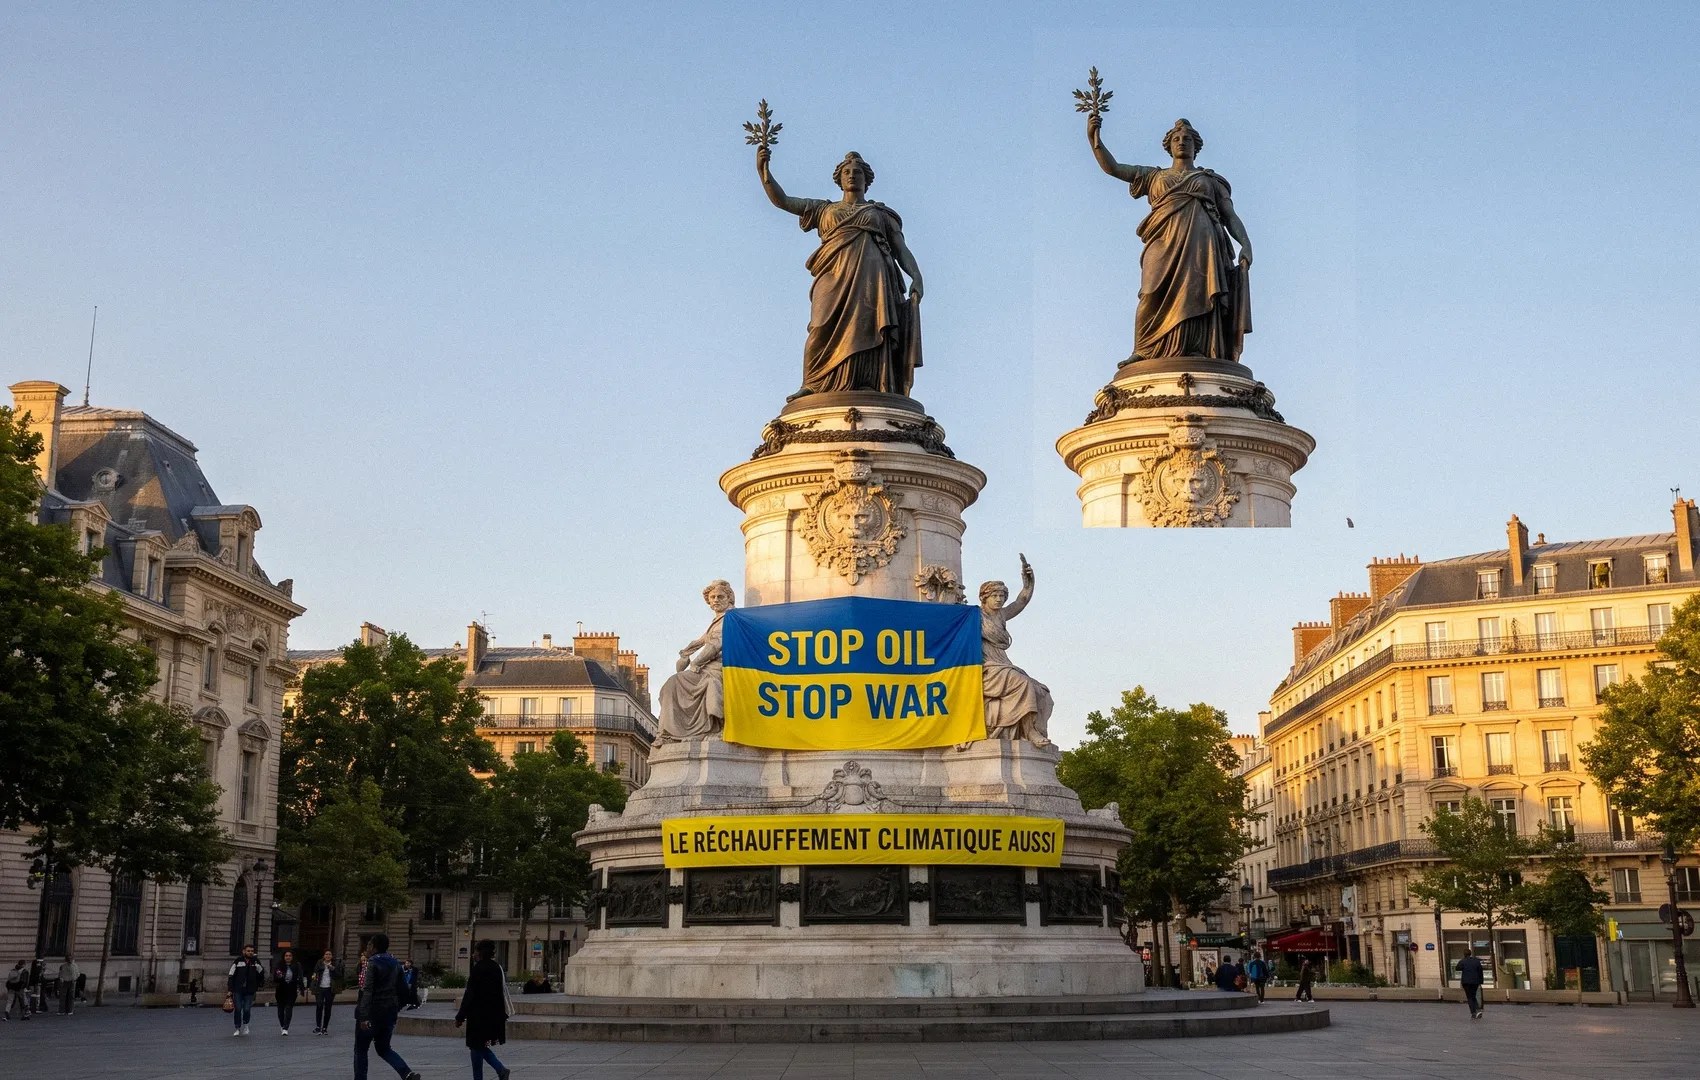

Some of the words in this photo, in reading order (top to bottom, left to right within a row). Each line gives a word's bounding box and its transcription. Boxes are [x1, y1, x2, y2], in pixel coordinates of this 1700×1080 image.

[767, 629, 864, 667] STOP
[876, 629, 936, 666] OIL
[757, 681, 853, 720] STOP
[865, 680, 950, 720] WAR
[669, 832, 689, 854] LE
[694, 825, 871, 853] RÉCHAUFFEMENT
[878, 827, 1003, 854] CLIMATIQUE
[1008, 829, 1056, 854] AUSSI
